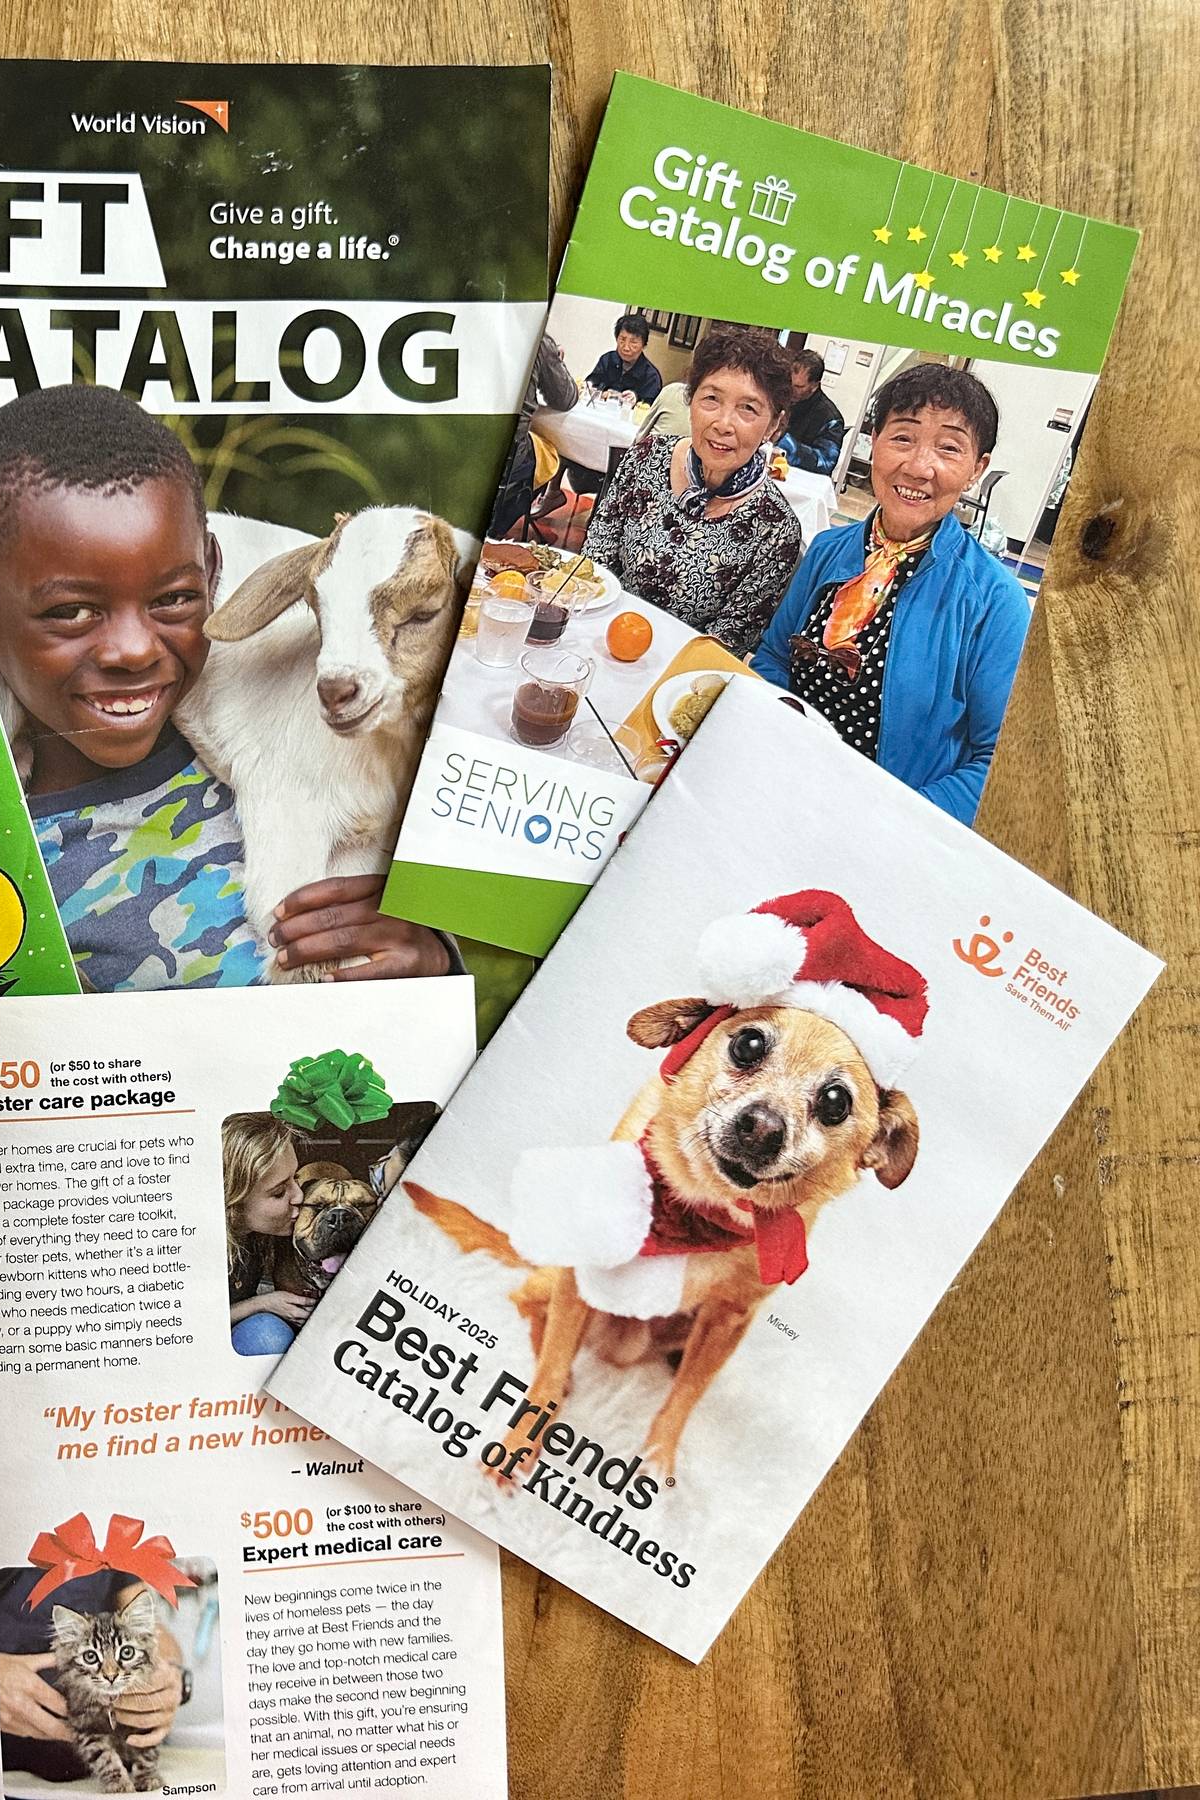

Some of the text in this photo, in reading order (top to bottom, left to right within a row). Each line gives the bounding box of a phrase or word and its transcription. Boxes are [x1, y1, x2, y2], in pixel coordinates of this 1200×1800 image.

[72, 111, 206, 135] World Vision
[653, 146, 743, 210] Gift
[210, 201, 338, 229] Give a gift.
[210, 236, 310, 264] Change
[317, 243, 331, 259] a
[619, 185, 1060, 358] Catalog of Miracles
[440, 752, 616, 826] SERVING
[431, 787, 606, 861] SENIORS
[1024, 948, 1068, 986] Best
[1005, 983, 1028, 1003] Save
[1029, 999, 1055, 1021] Them
[1012, 966, 1079, 1020] Friends
[50, 1060, 66, 1074] (or
[68, 1058, 91, 1072] $50
[93, 1060, 105, 1070] to
[107, 1057, 142, 1070] share
[50, 1070, 172, 1088] the cost with others)
[39, 1094, 85, 1110] care
[90, 1089, 176, 1111] package
[11, 1144, 52, 1156] homes
[56, 1143, 74, 1153] are
[78, 1140, 117, 1152] crucial
[120, 1139, 136, 1149] for
[139, 1138, 165, 1150] pets
[168, 1136, 194, 1146] who
[385, 1269, 500, 1350] HOLIDAY 2025
[355, 1289, 480, 1395] Best
[767, 1314, 800, 1341] Mickey
[103, 1401, 182, 1425] foster
[189, 1393, 267, 1419] family
[57, 1441, 98, 1460] me
[107, 1433, 158, 1457] find
[165, 1436, 180, 1453] a
[188, 1431, 243, 1451] new
[306, 1459, 364, 1476] Walnut
[332, 1339, 698, 1590] Catalog of Kindness
[240, 1502, 422, 1539] $500 (or $100 to share
[327, 1515, 445, 1532] the cost with others)
[243, 1535, 442, 1564] Expert medical care
[244, 1580, 442, 1605] New beginnings come twice in the
[162, 1781, 217, 1796] Sampson
